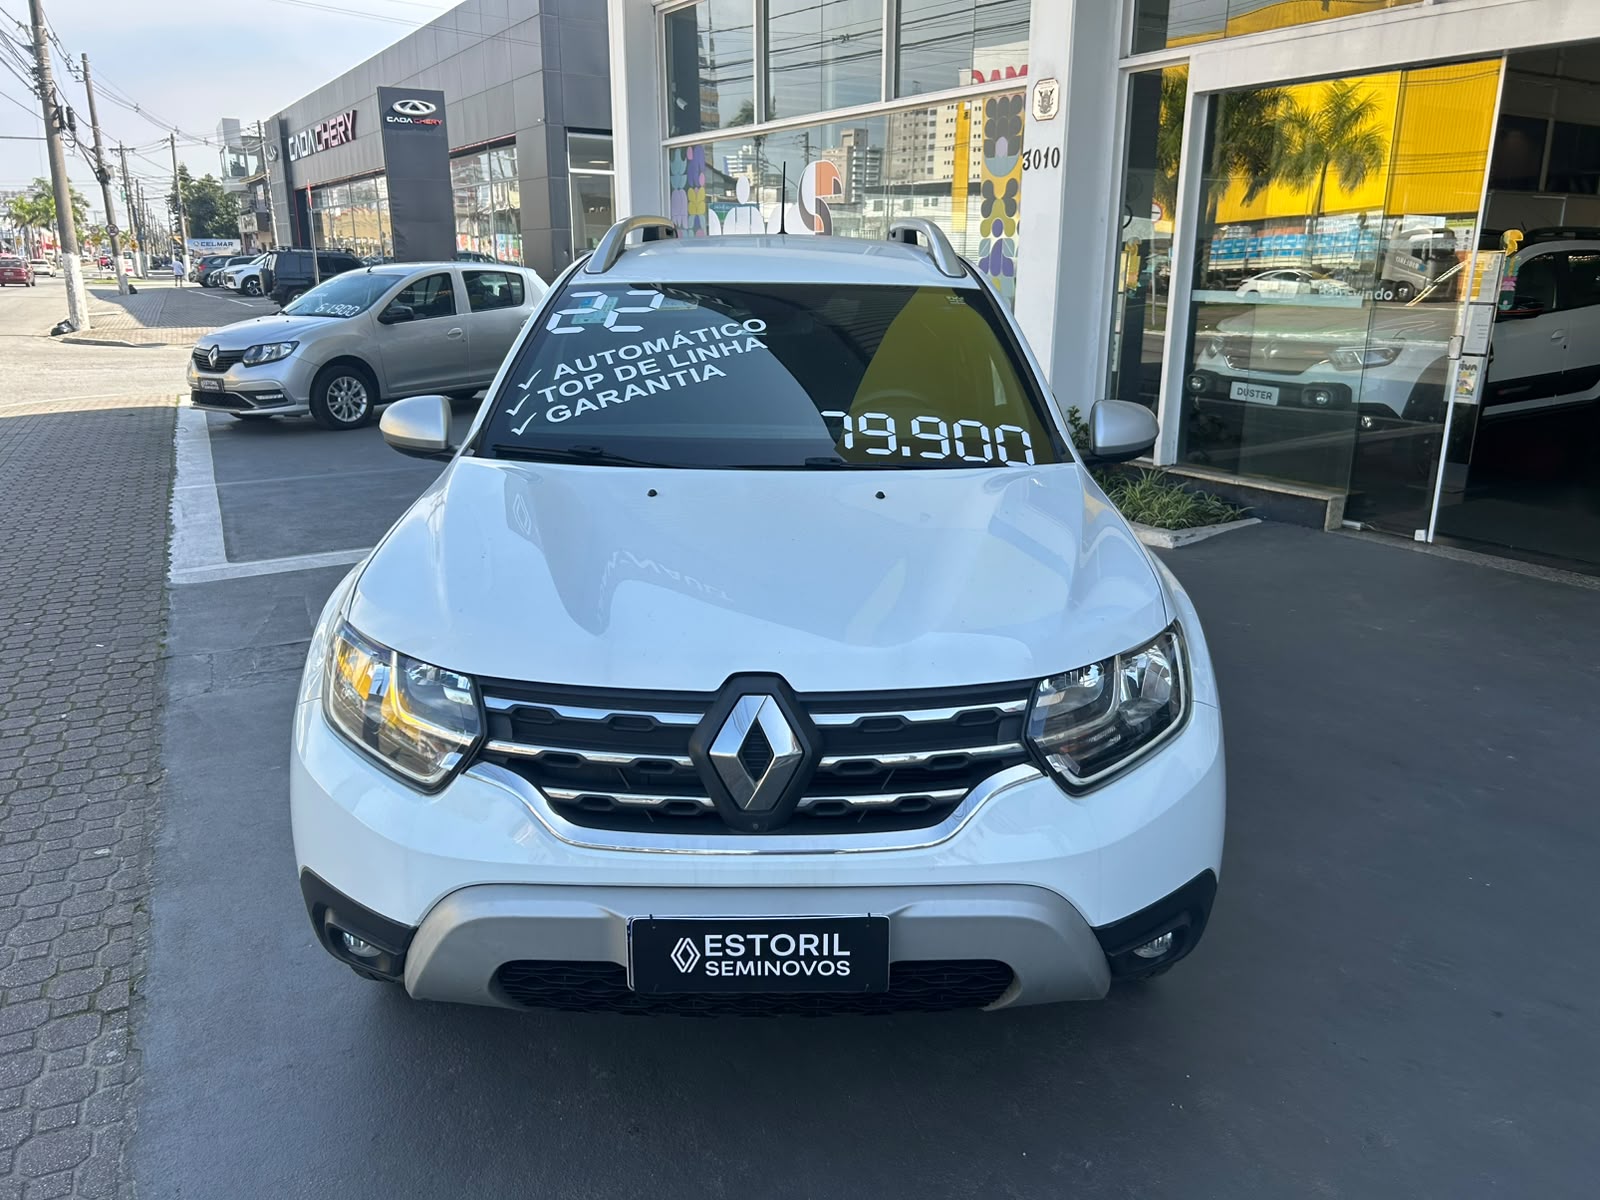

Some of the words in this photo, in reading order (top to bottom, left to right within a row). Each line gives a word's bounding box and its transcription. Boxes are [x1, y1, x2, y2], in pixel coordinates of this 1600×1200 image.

[1022, 146, 1060, 171] 3010
[546, 290, 665, 335] 22
[537, 372, 604, 403] TOP
[614, 358, 661, 382] DE
[667, 337, 768, 368] LINHA
[553, 318, 767, 380] AUTOMÁTICO
[545, 364, 727, 423] GARANTIA
[1236, 387, 1273, 400] DUSTER
[820, 410, 1036, 466] 79.900
[704, 933, 850, 957] ESTORIL
[705, 960, 850, 976] SEMINOVOS
